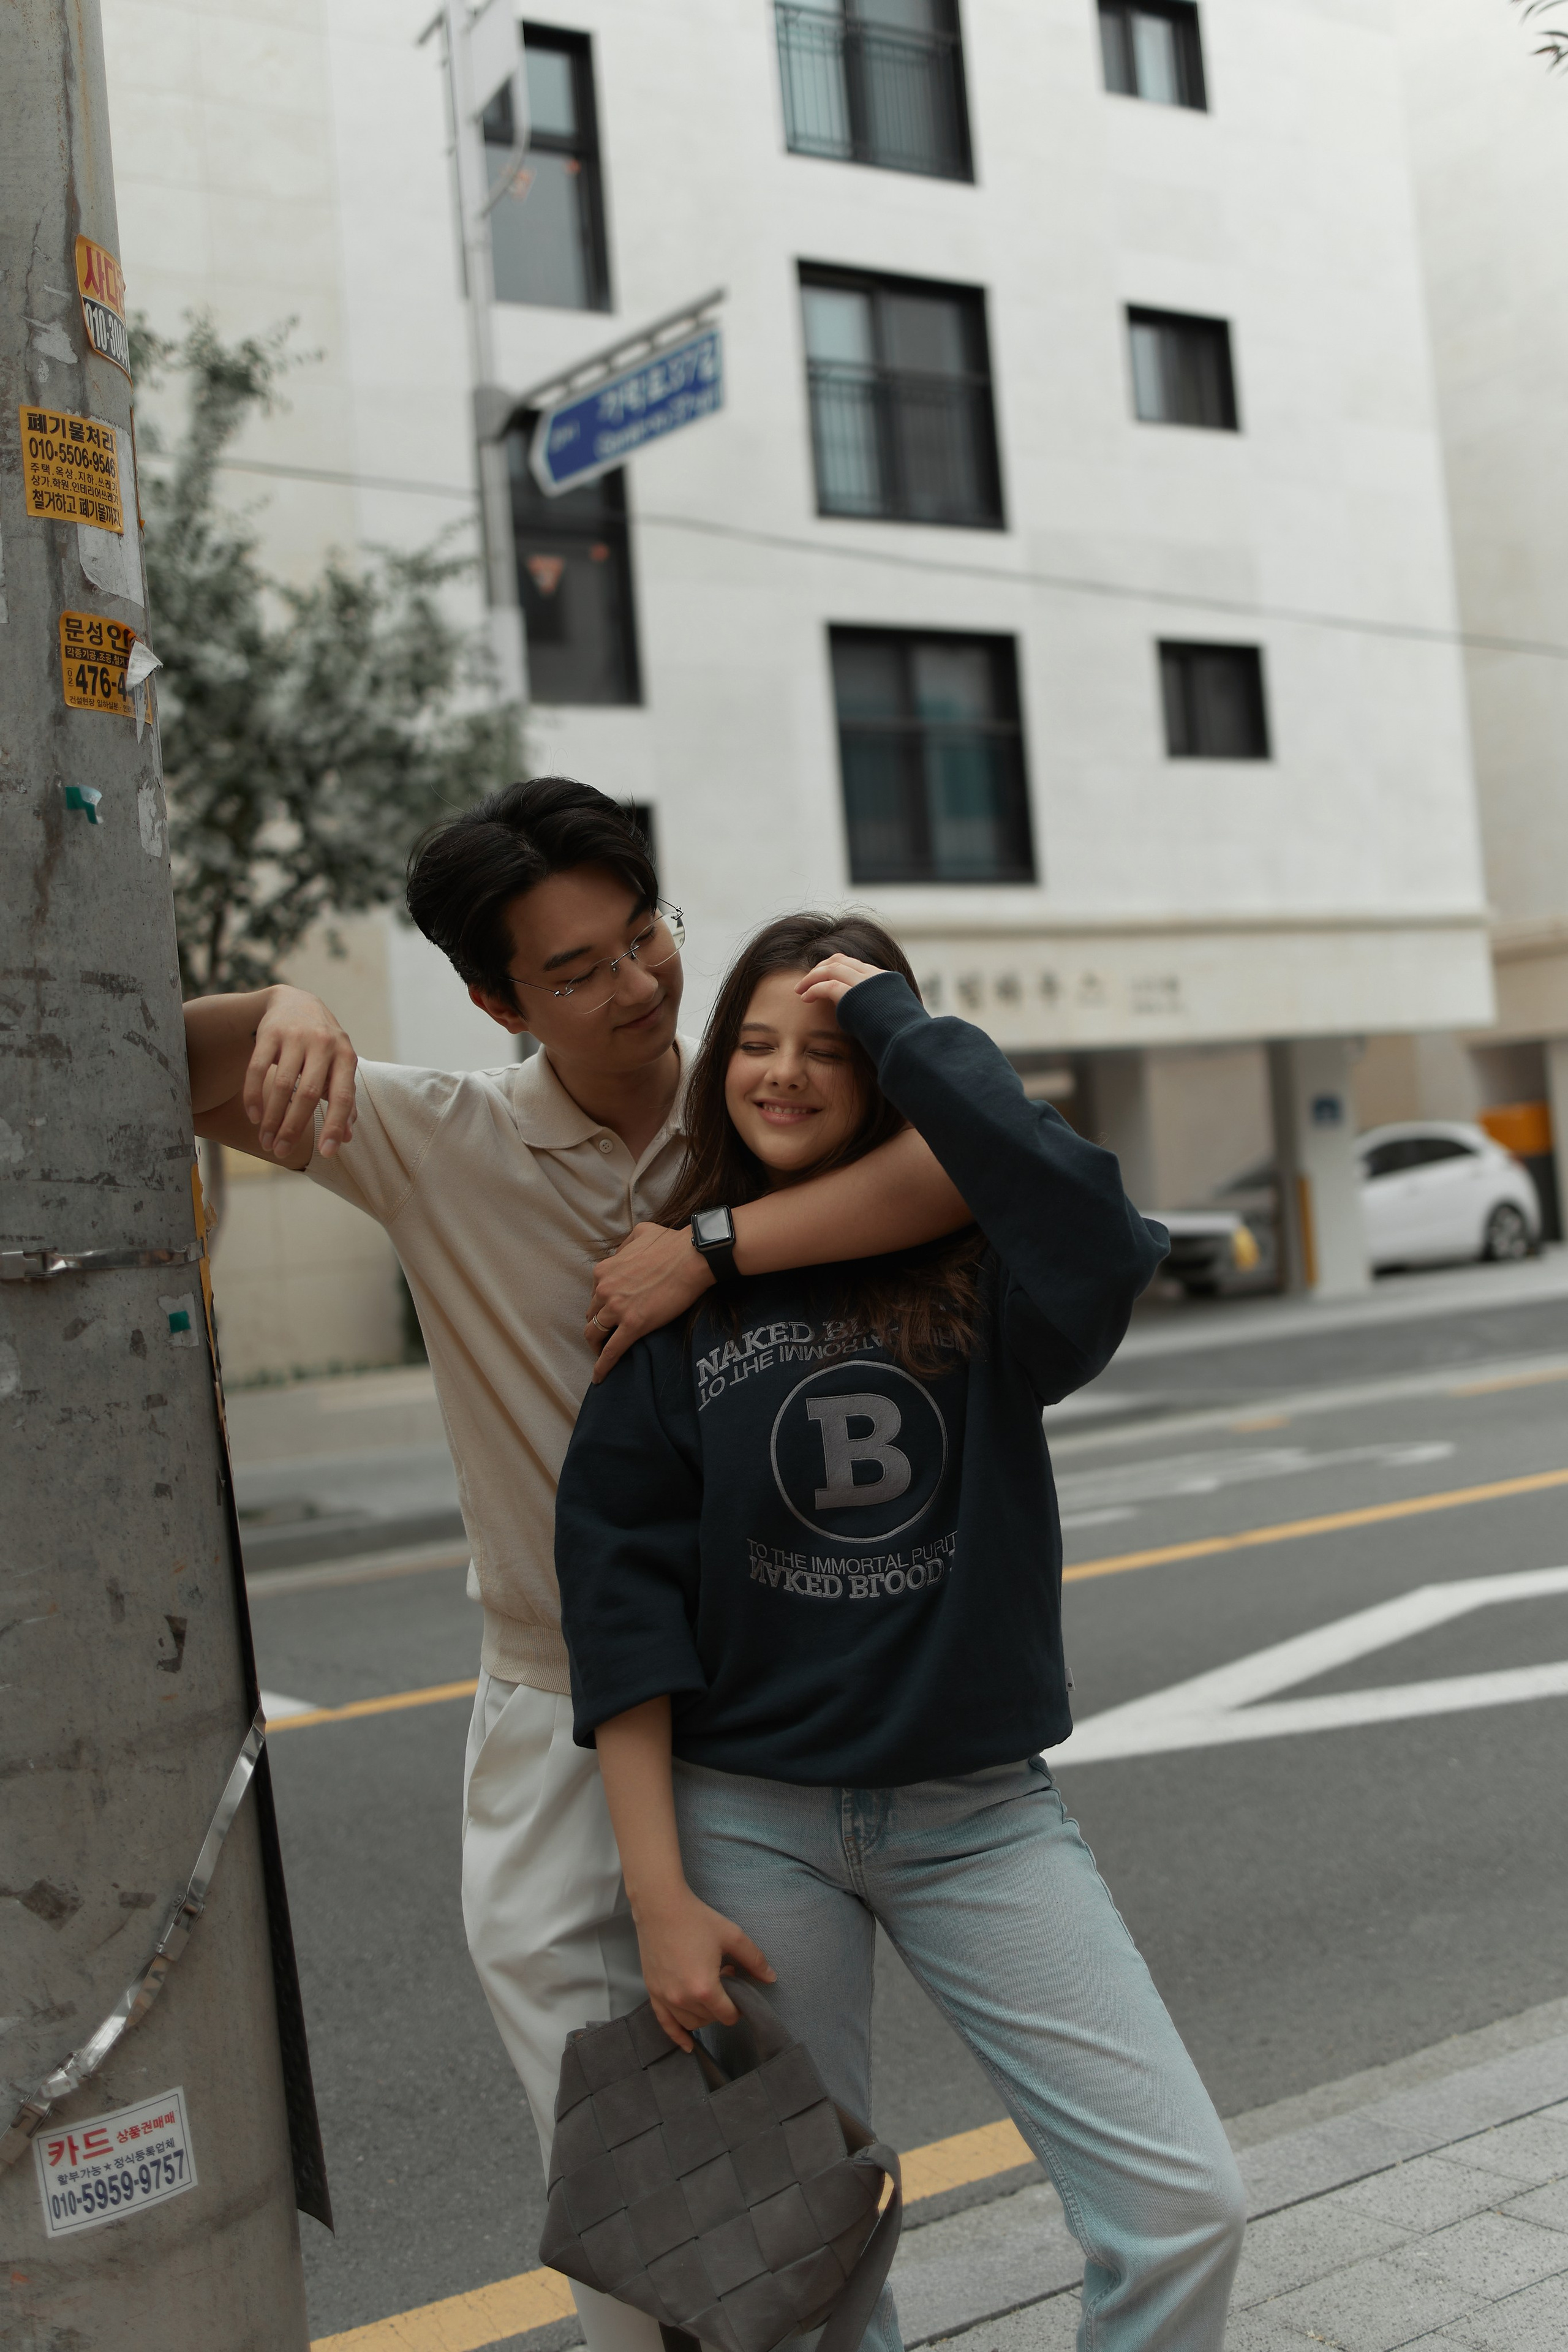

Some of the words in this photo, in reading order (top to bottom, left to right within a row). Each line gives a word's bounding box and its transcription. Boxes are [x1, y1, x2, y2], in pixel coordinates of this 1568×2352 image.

[27, 412, 115, 454] 폐기물처리
[29, 437, 116, 479] 010-5506-9546
[32, 489, 77, 514] 철거하고
[65, 617, 129, 654] 문성인
[69, 696, 94, 706] 건설현장
[696, 1321, 815, 1387] NAKED
[805, 1393, 912, 1510] B
[746, 1537, 767, 1559] TO
[771, 1548, 807, 1570] THE
[811, 1552, 910, 1575] IMMORTAL
[911, 1530, 958, 1565] PURIT
[48, 2128, 114, 2167] 카드
[116, 2111, 176, 2144] 상품권매매
[51, 2149, 184, 2220] 010-5959-9757
